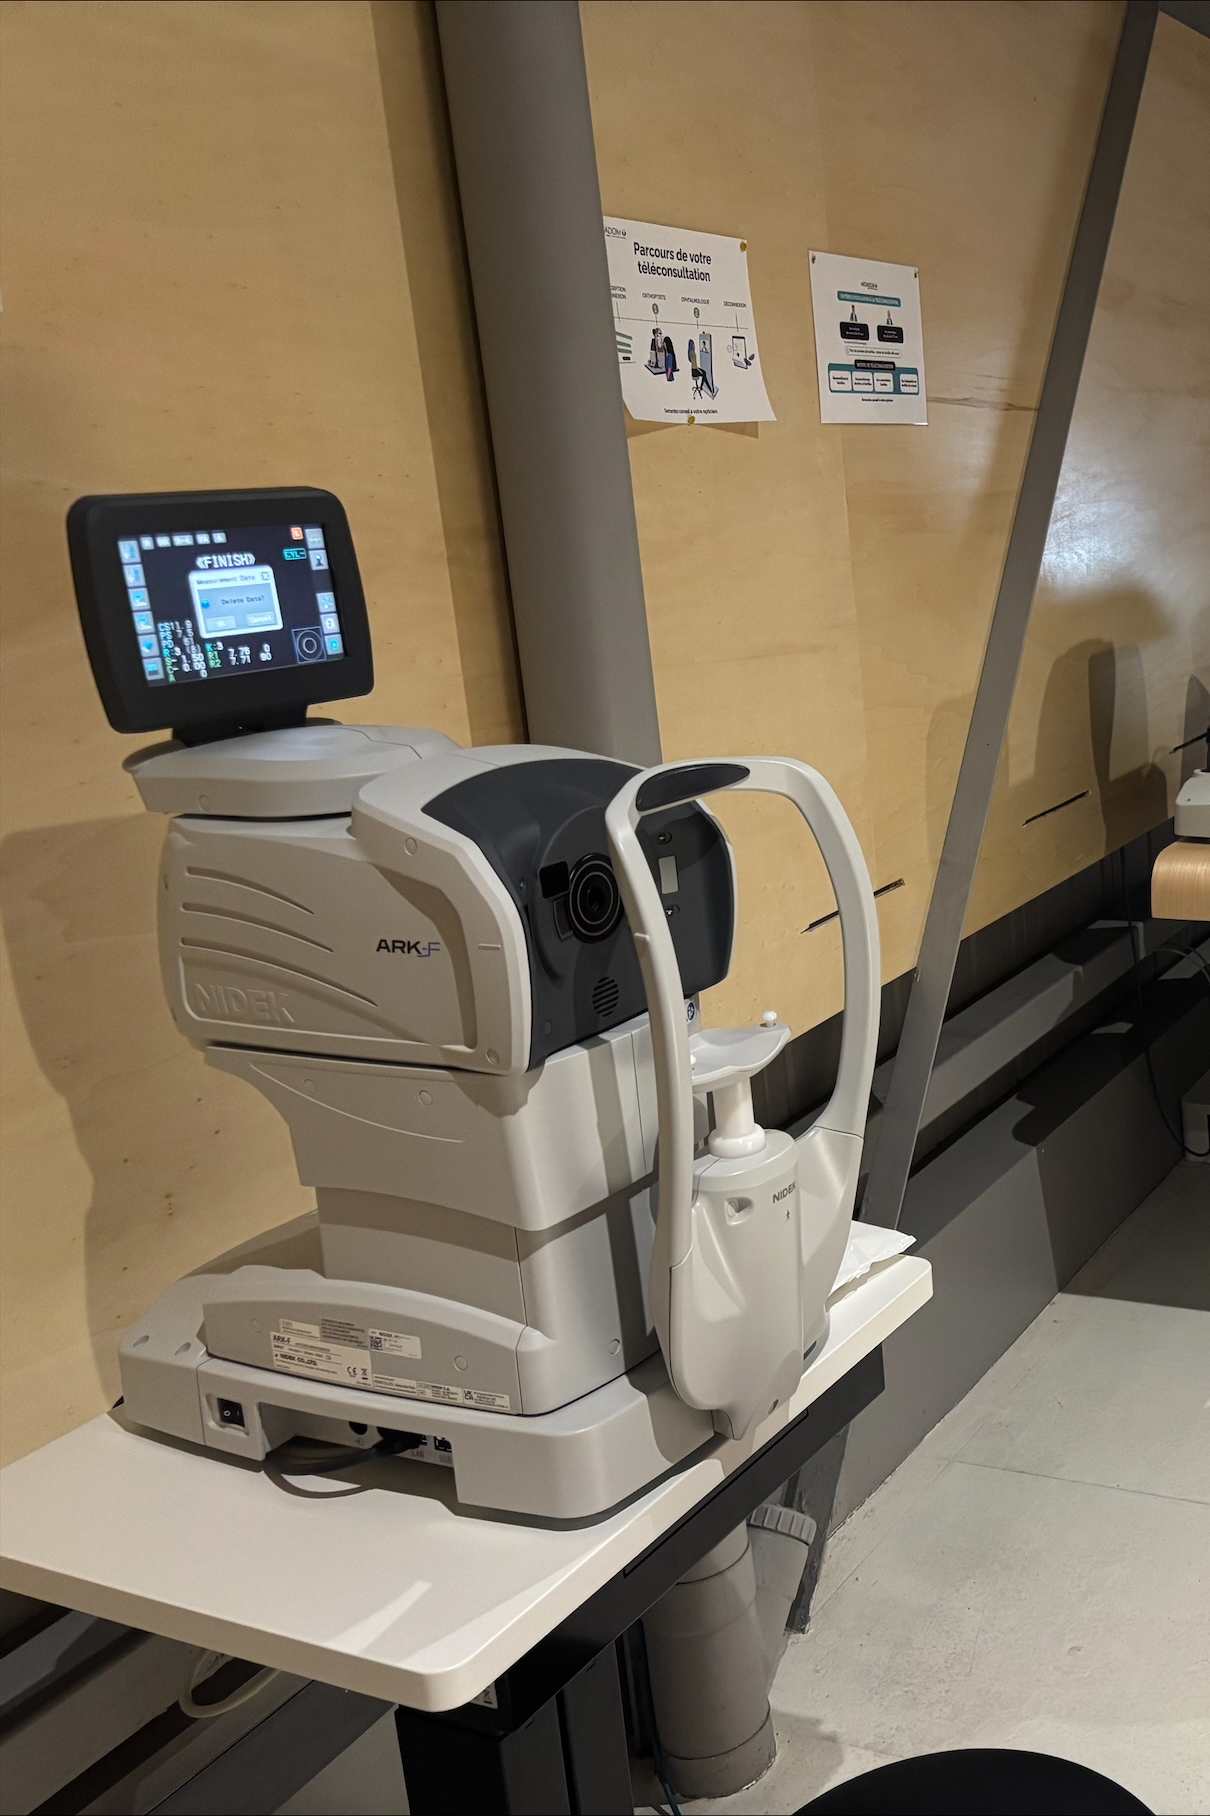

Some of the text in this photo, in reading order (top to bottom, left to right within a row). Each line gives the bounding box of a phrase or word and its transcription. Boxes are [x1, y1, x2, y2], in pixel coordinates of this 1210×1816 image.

[633, 241, 712, 265] Parcours de votre
[637, 260, 711, 282] téléconsultation
[375, 938, 441, 958] ARK-F
[193, 982, 296, 1023] NIDEK
[772, 1179, 797, 1204] NIDEK
